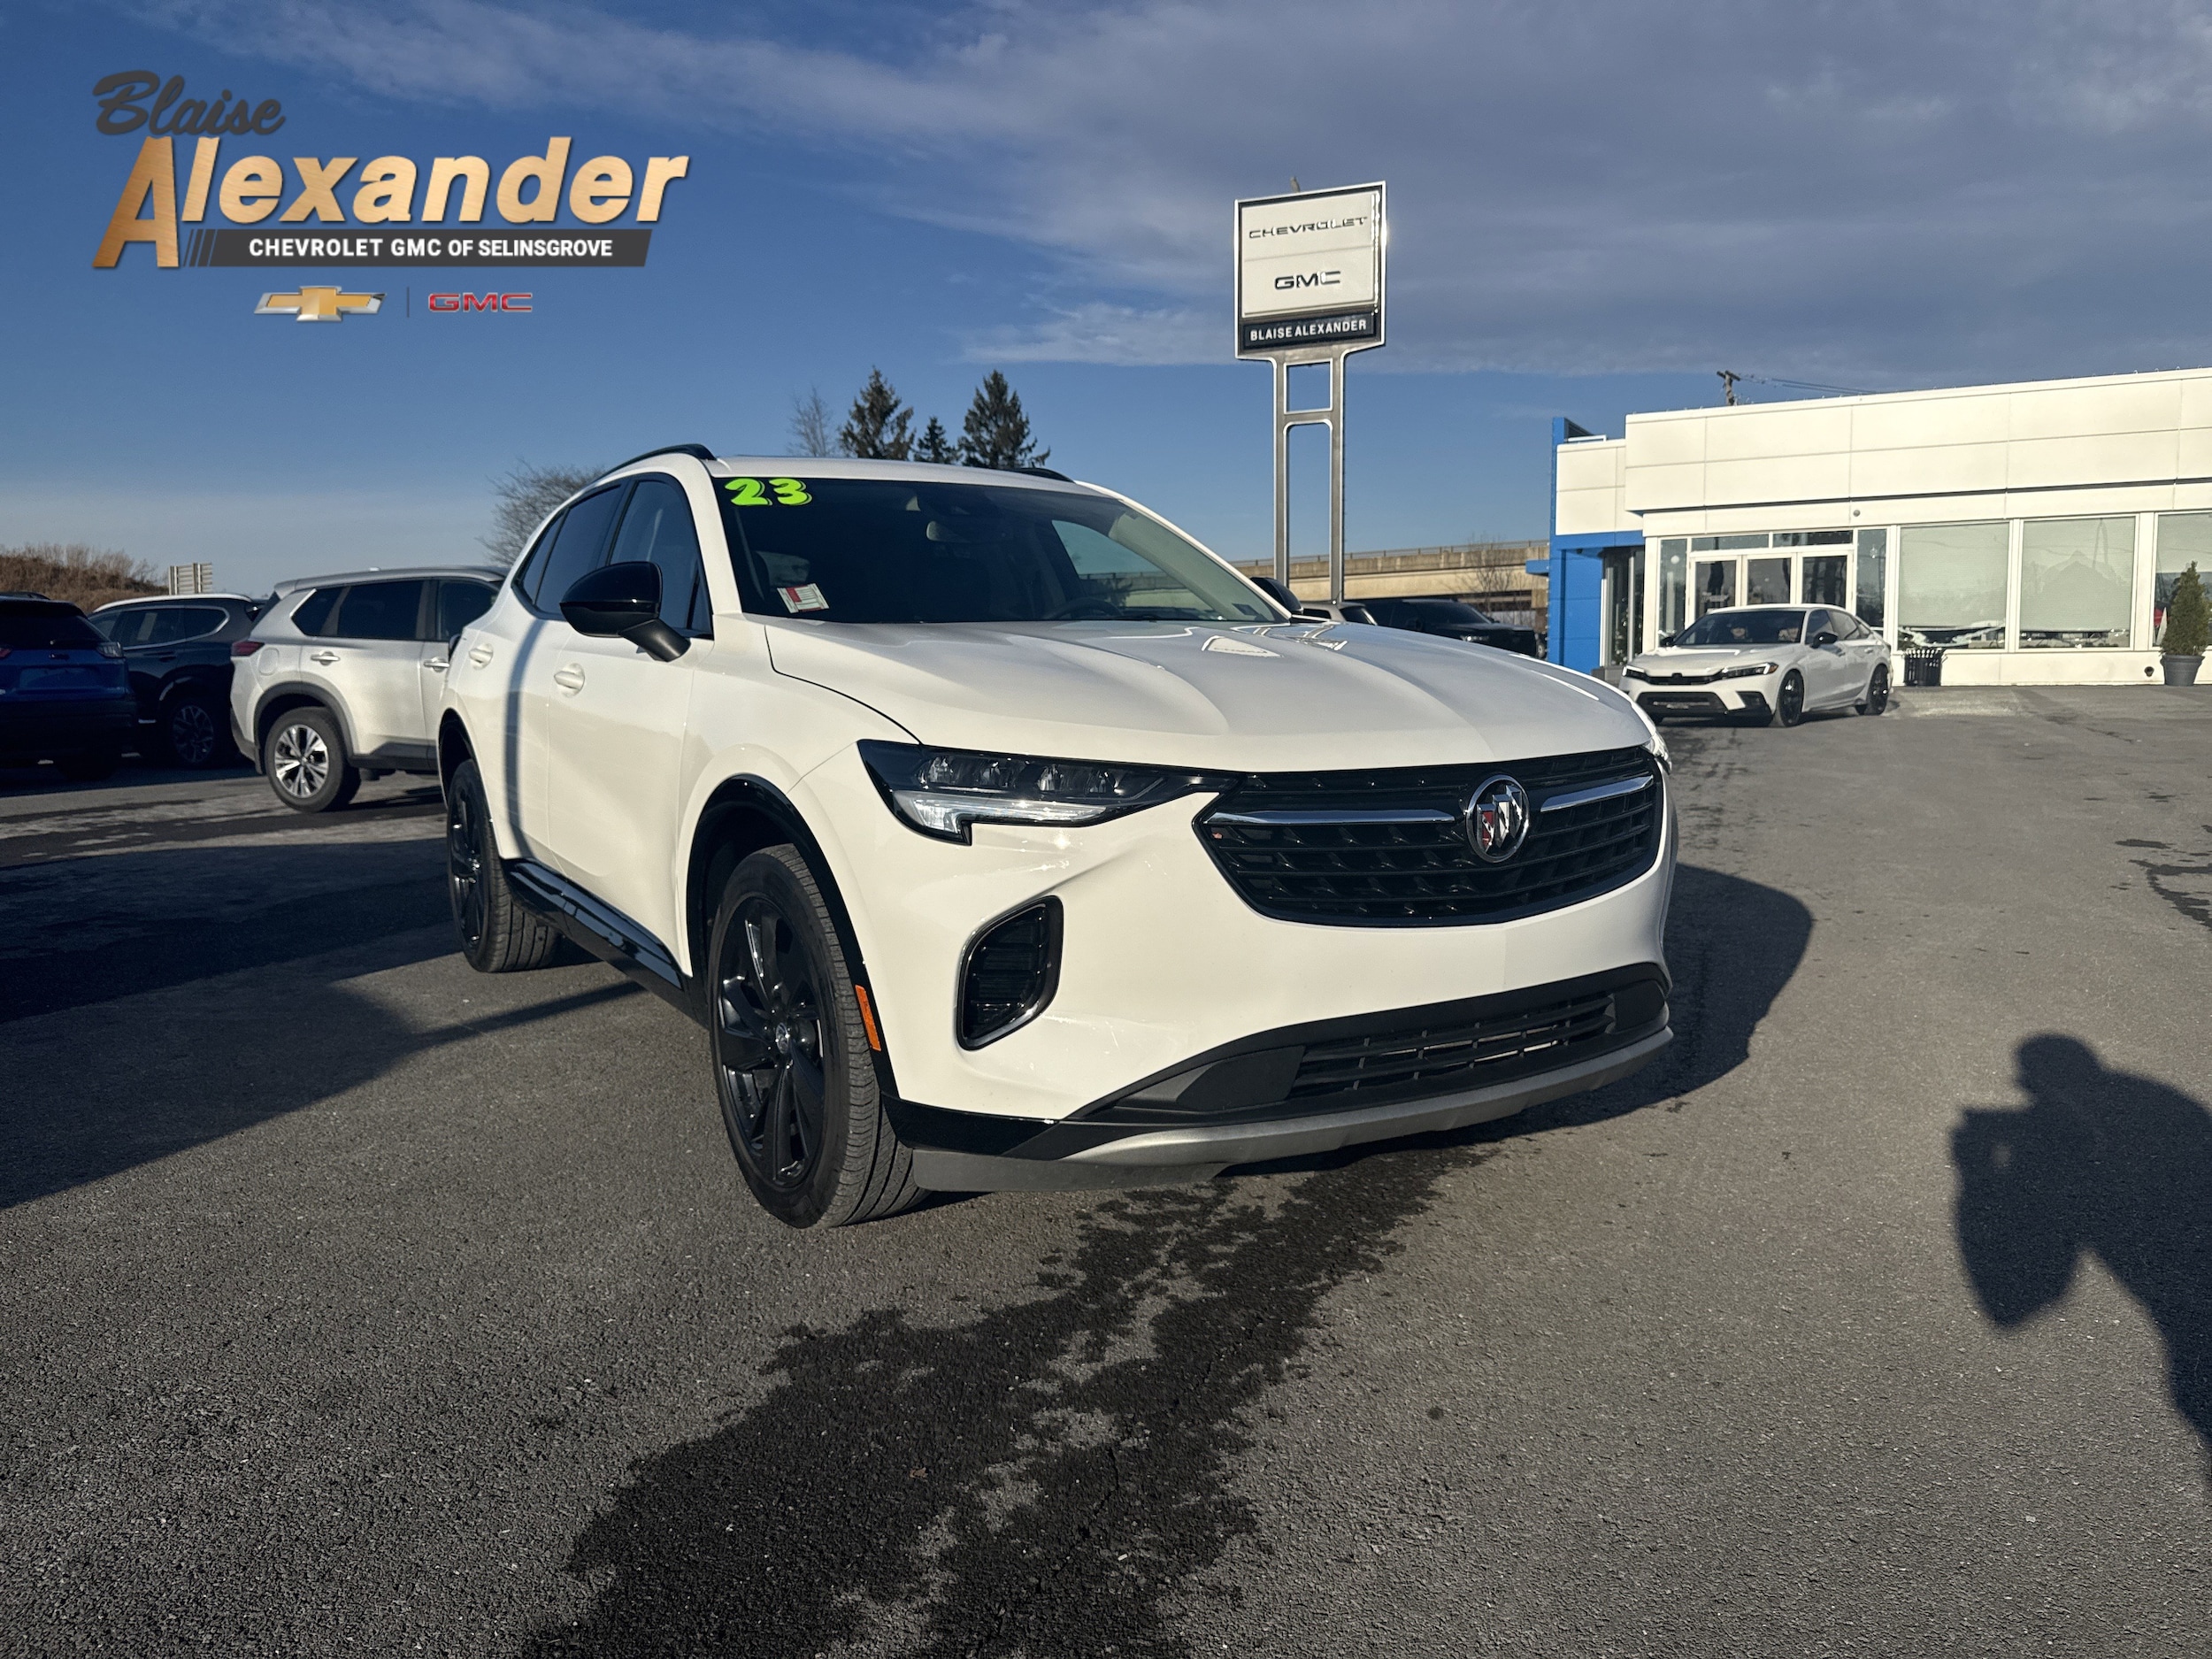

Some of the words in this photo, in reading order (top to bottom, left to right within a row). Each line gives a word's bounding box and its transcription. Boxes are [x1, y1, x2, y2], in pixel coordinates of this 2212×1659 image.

[1249, 217, 1368, 239] CHEVROLET
[1275, 270, 1341, 290] GMC
[1250, 326, 1293, 342] BLAISE
[1294, 319, 1367, 337] ALEXANDER
[724, 478, 812, 506] 23
